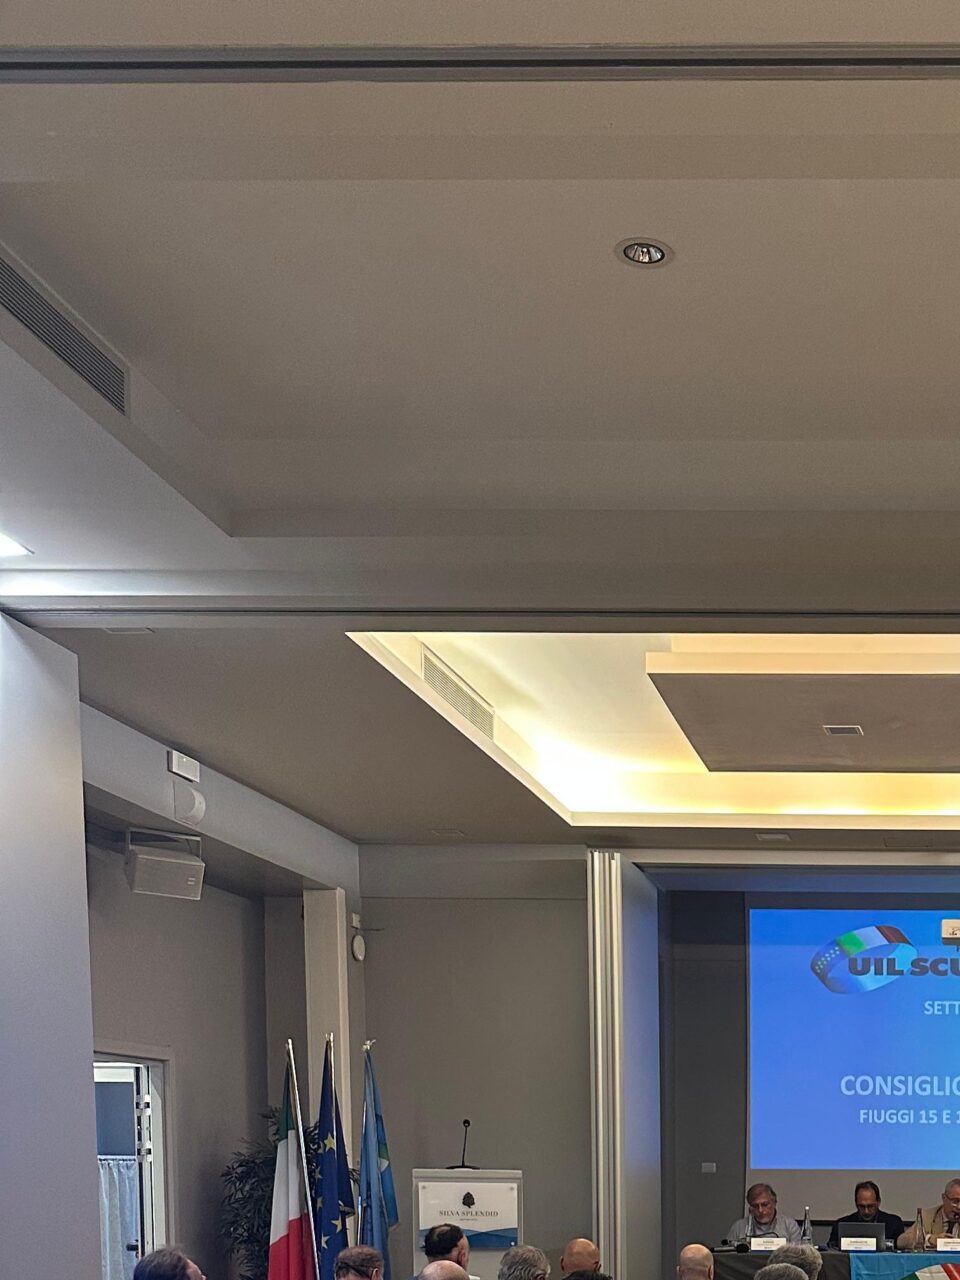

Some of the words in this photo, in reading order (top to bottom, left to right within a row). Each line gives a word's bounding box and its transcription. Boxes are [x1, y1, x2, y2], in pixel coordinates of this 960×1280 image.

[848, 957, 904, 976] UIL
[859, 1109, 914, 1124] FIUGGI
[919, 1109, 937, 1124] 15
[943, 1109, 951, 1124] E
